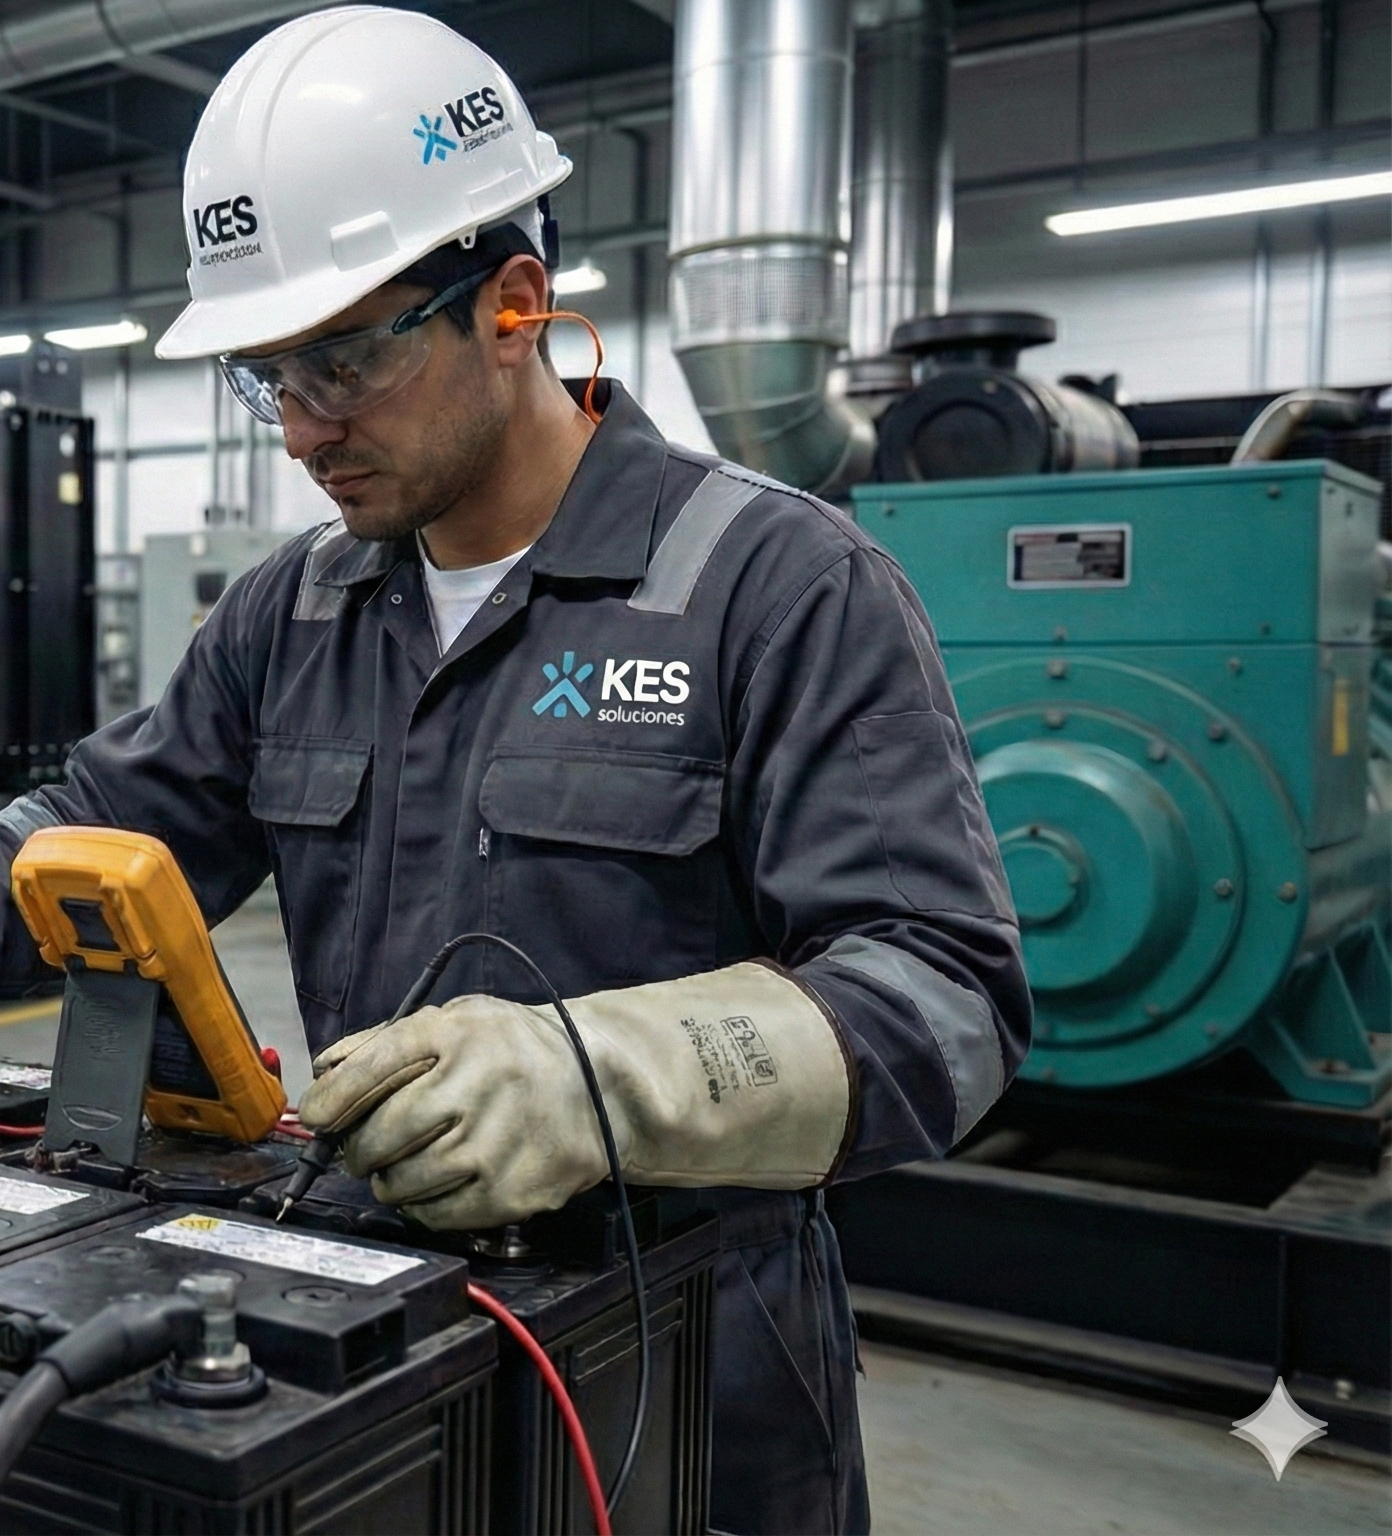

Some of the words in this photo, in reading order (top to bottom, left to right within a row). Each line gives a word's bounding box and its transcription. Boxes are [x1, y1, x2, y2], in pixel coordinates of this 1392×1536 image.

[444, 86, 504, 138] KES
[193, 194, 258, 248] KES
[601, 658, 691, 704] KES
[597, 705, 685, 726] soluciones
